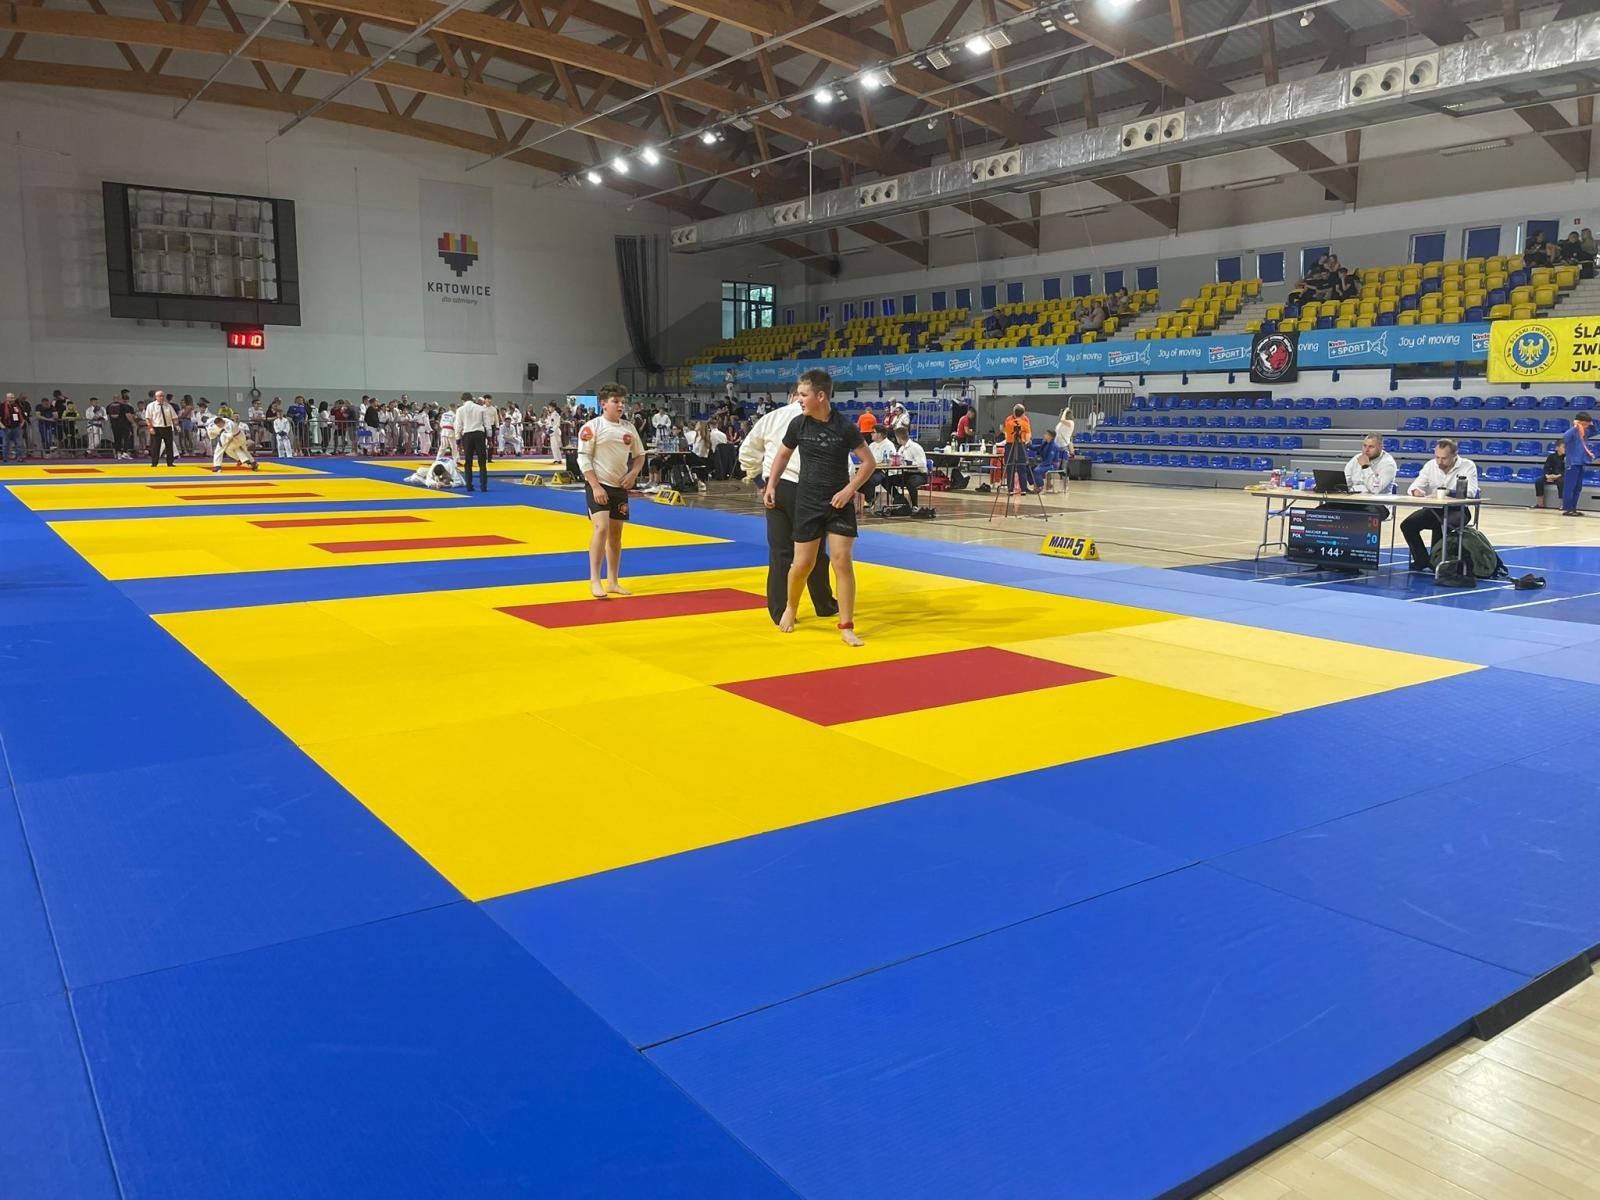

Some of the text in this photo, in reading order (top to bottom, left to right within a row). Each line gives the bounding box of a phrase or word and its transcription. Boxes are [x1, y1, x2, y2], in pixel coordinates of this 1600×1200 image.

[427, 281, 491, 296] KATOWICE
[1297, 342, 1319, 352] oving
[1398, 334, 1460, 348] Joy of moving
[1159, 348, 1201, 359] Joy of moving
[1049, 535, 1086, 556] MATA 5
[1371, 535, 1378, 544] 0
[1089, 543, 1096, 556] 5
